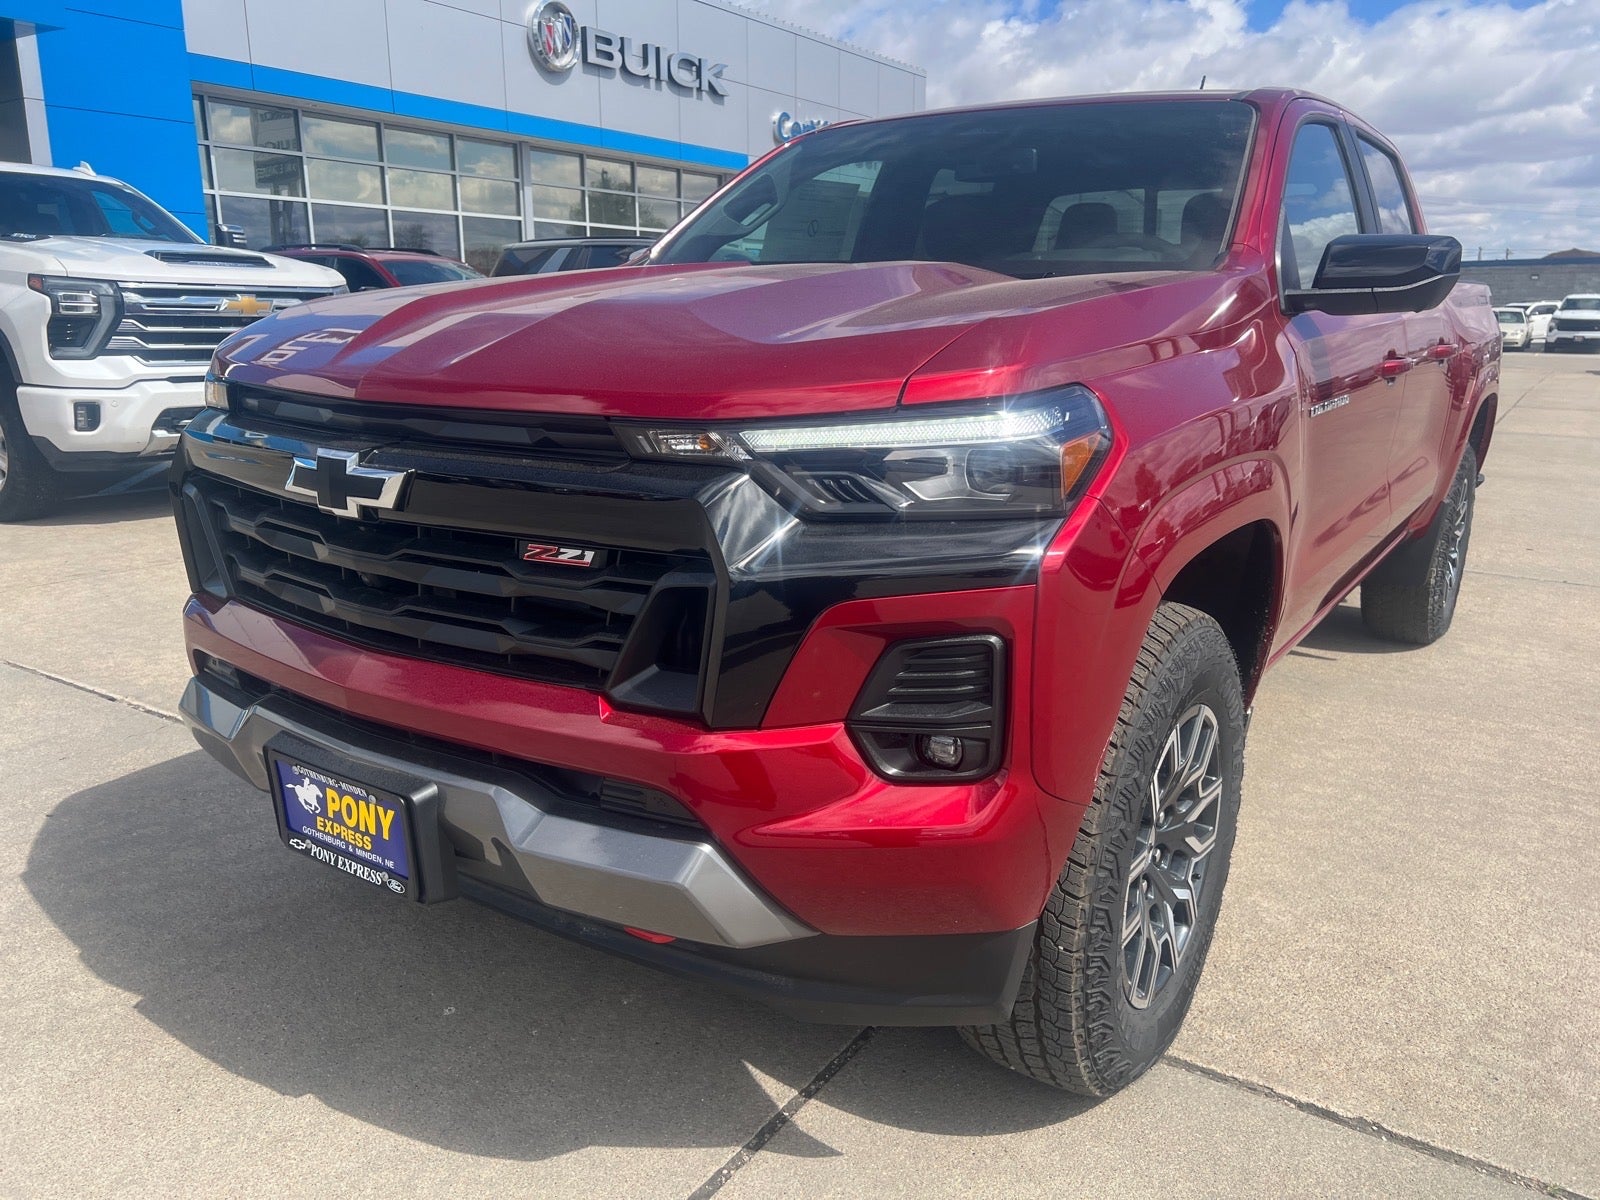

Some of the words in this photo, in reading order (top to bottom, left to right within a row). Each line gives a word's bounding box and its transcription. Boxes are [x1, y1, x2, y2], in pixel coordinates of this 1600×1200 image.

[581, 25, 730, 97] BUICK
[523, 543, 595, 567] Z71
[316, 816, 372, 851] EXPRESS
[326, 788, 395, 840] PONY
[302, 825, 346, 849] GOTHENBURG
[348, 844, 353, 853] &
[355, 847, 384, 866] MINDEN,
[385, 858, 395, 869] NE
[311, 844, 337, 866] PONY
[337, 855, 382, 885] EXPRESS
